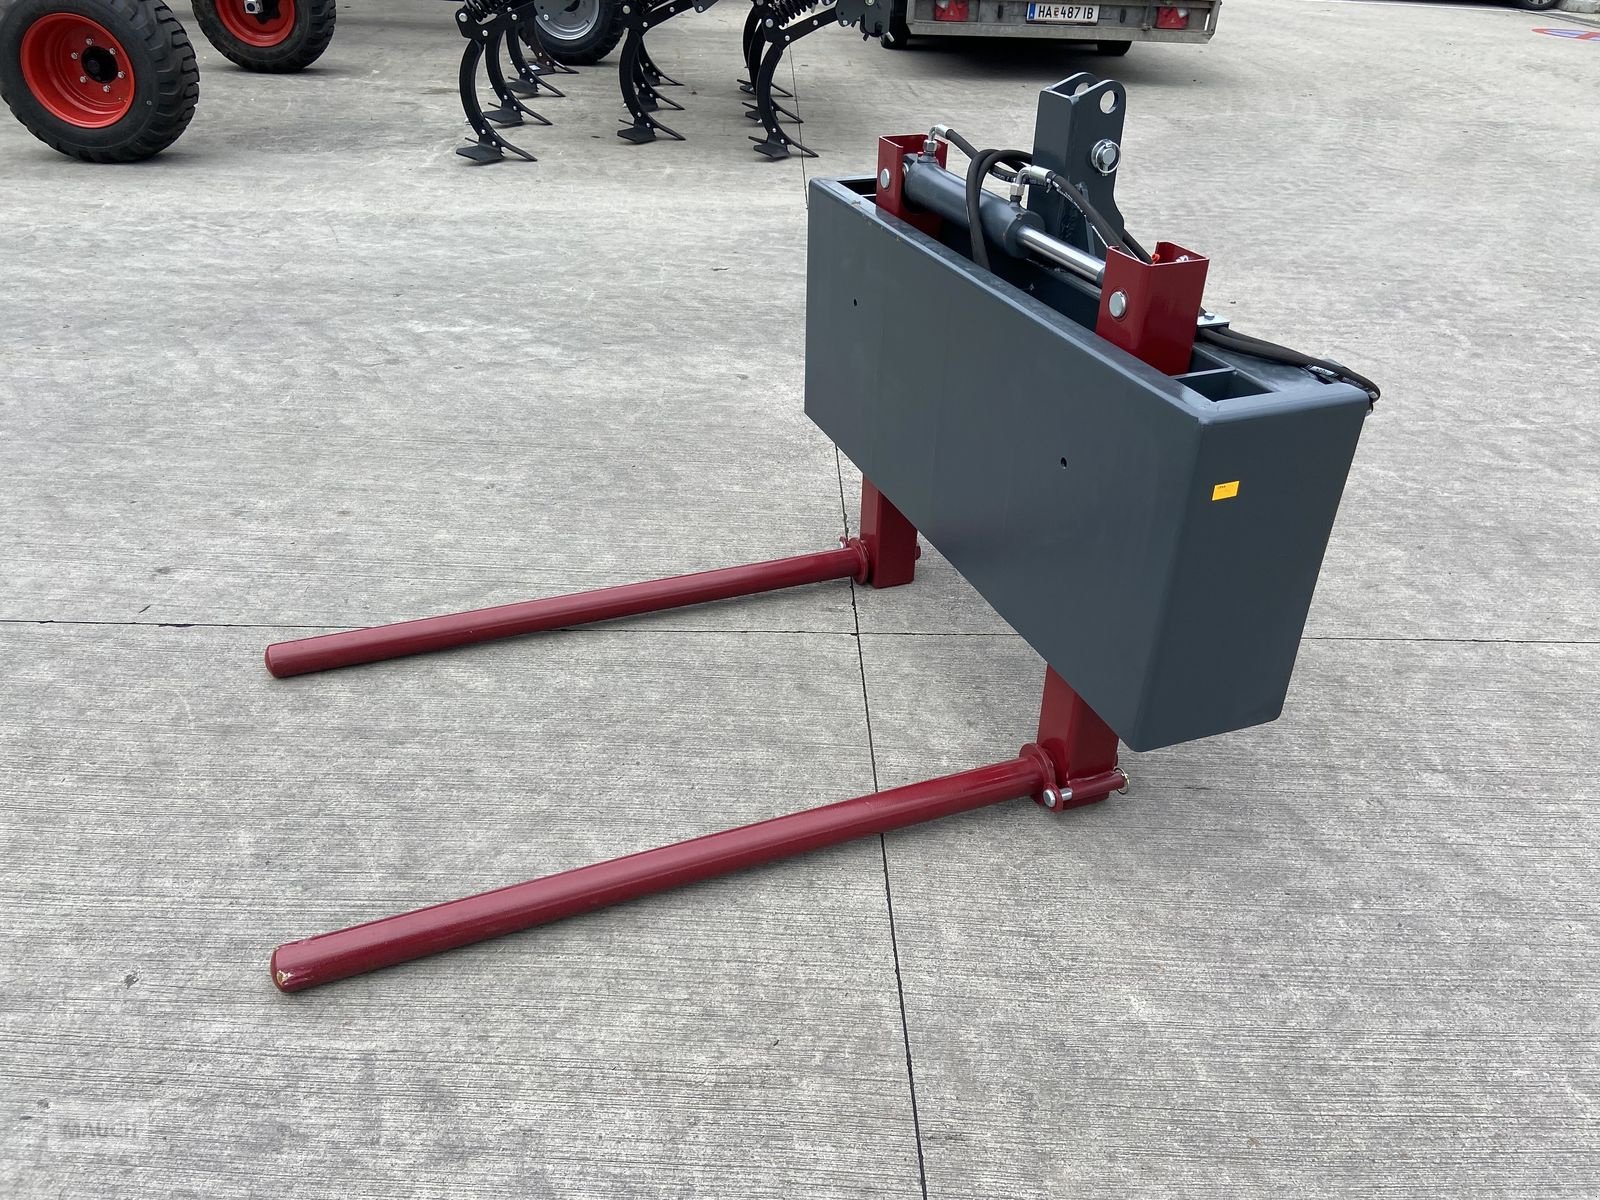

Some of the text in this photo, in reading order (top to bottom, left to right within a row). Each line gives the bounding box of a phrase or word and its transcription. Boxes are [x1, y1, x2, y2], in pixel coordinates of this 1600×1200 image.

[1038, 5, 1094, 19] HA 487 IB
